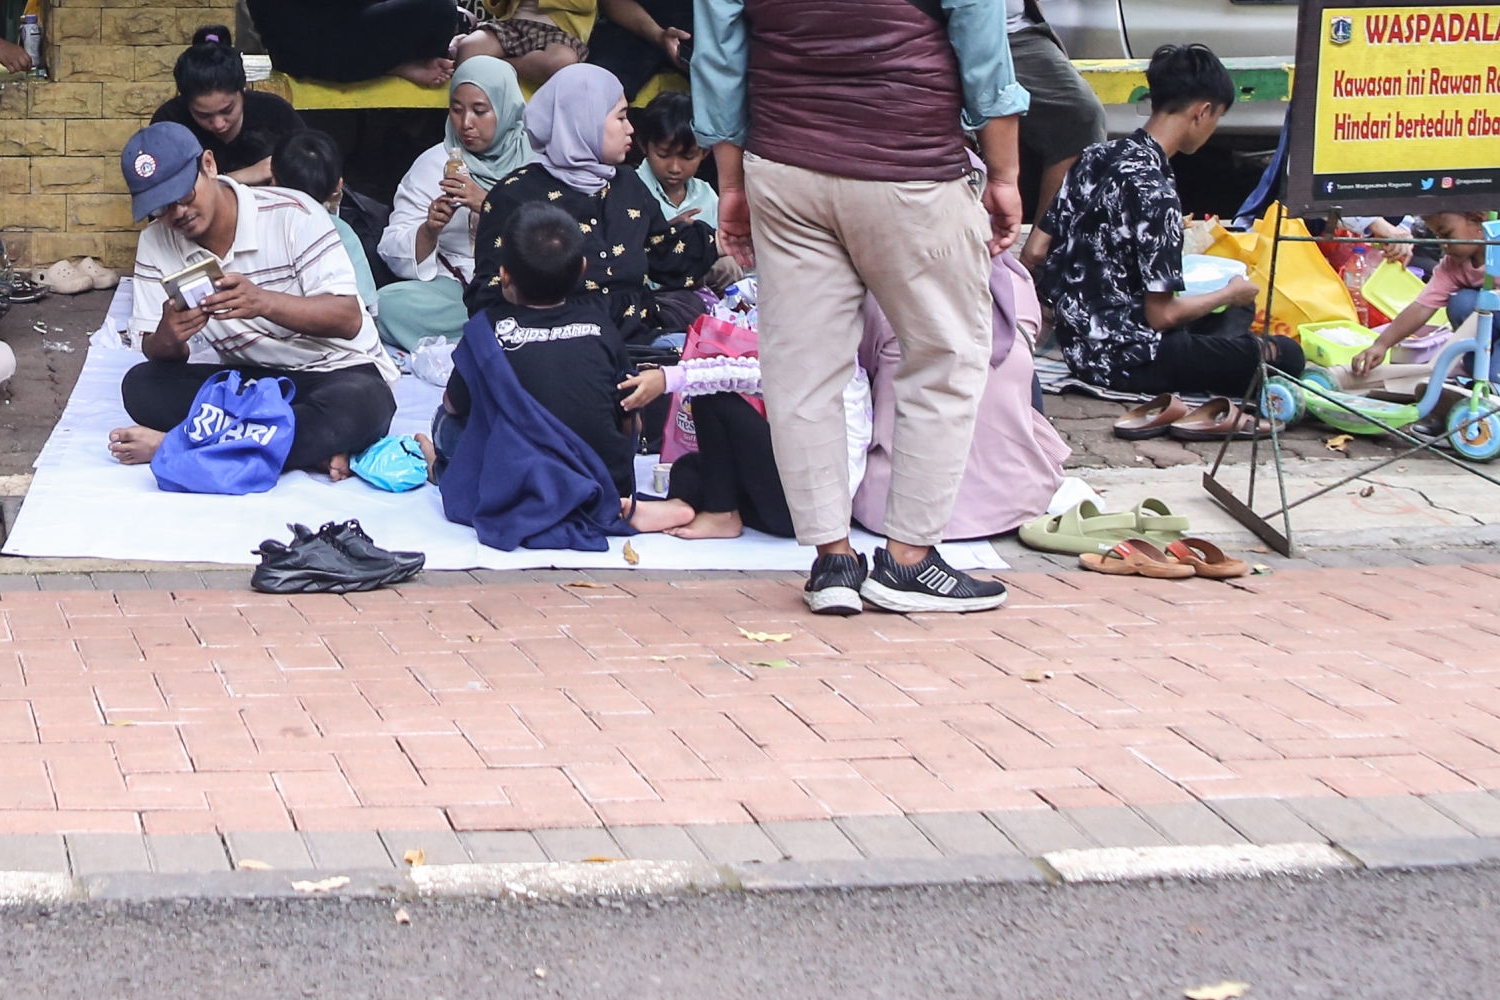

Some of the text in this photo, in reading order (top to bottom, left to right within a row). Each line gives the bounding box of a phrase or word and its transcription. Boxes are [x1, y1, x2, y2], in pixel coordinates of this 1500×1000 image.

[1332, 69, 1401, 98] Kawasan
[1406, 68, 1426, 96] ini
[1429, 67, 1482, 96] Rawan
[1333, 111, 1392, 141] Hindari
[1394, 109, 1463, 139] berteduh
[512, 323, 602, 343] KIDS PANDA
